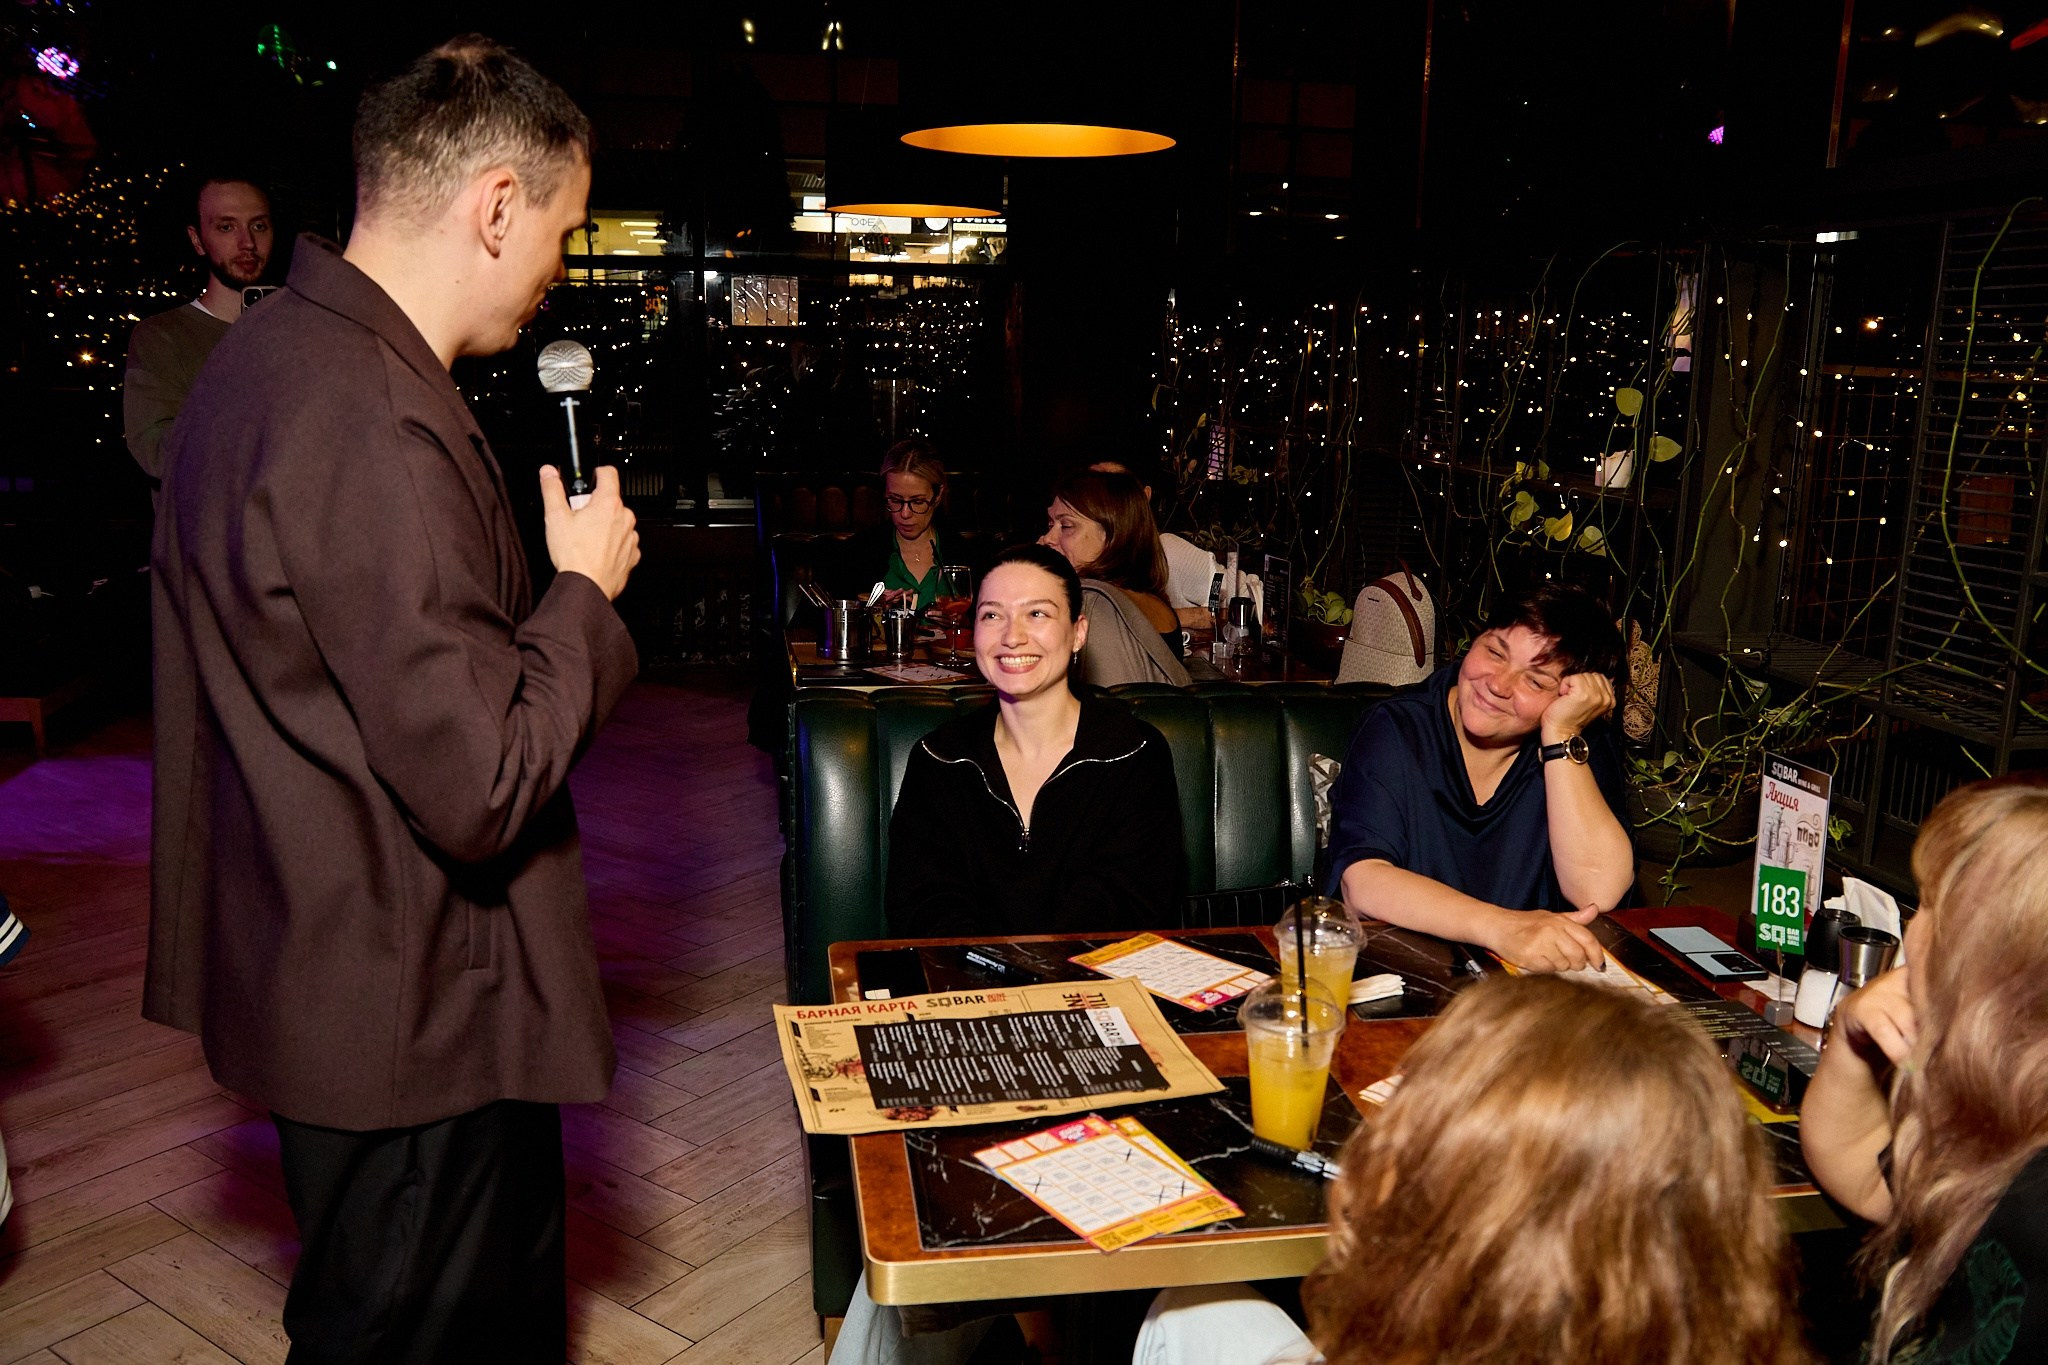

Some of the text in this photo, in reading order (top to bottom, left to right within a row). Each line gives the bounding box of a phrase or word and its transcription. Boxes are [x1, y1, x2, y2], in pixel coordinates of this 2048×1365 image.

[1765, 781, 1799, 811] Акция
[1760, 882, 1801, 918] 183
[796, 1000, 918, 1020] БАРНАЯ КАРТА
